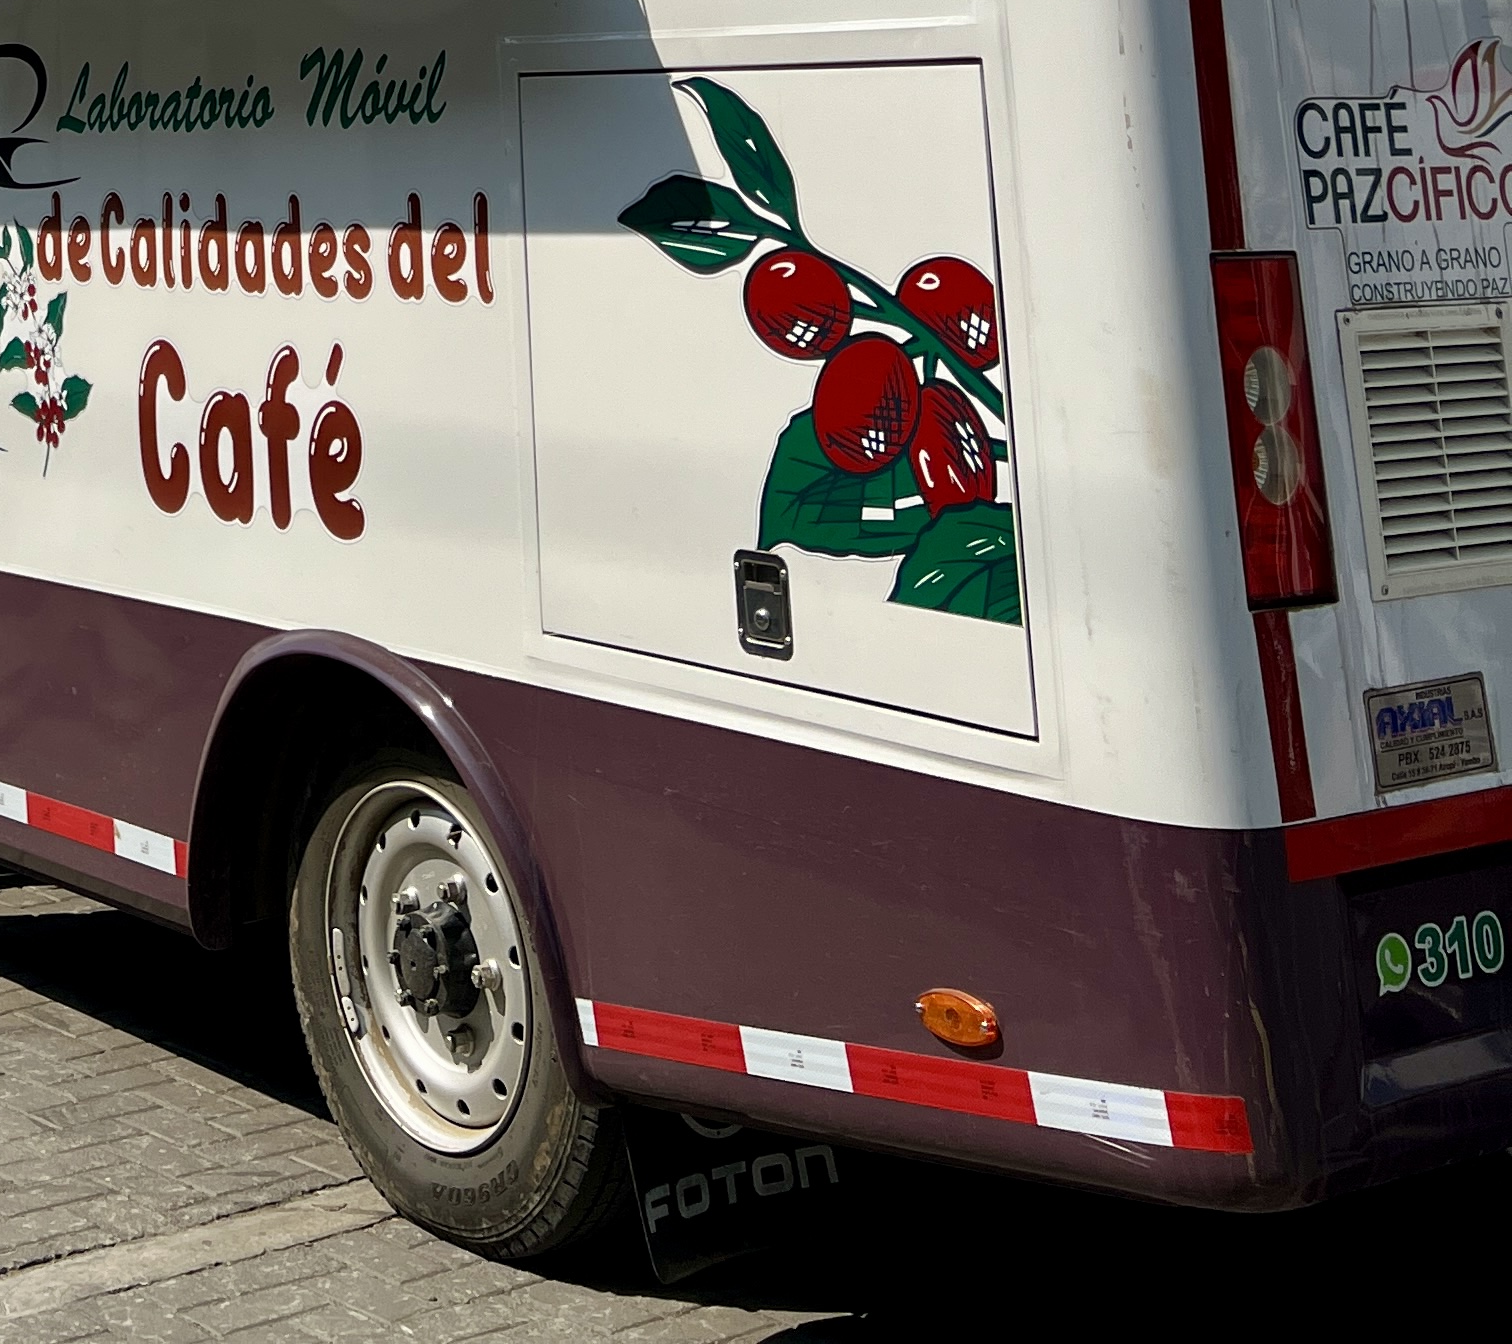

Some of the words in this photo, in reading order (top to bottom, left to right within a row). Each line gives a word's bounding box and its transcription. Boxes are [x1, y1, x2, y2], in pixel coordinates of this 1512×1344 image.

[56, 60, 275, 134] Laboratorio
[299, 46, 449, 130] Móvil
[1296, 89, 1413, 160] CAFÉ
[388, 190, 495, 305] del
[1347, 250, 1415, 275] GRANO
[1419, 249, 1433, 272] A
[1435, 246, 1502, 271] GRANO
[1351, 278, 1478, 303] CONSTRUYENDO
[1480, 277, 1510, 297] PAZ
[138, 338, 365, 541] Café
[1398, 750, 1420, 767] PBX
[1415, 910, 1504, 987] 310
[644, 1144, 840, 1234] FOTON
